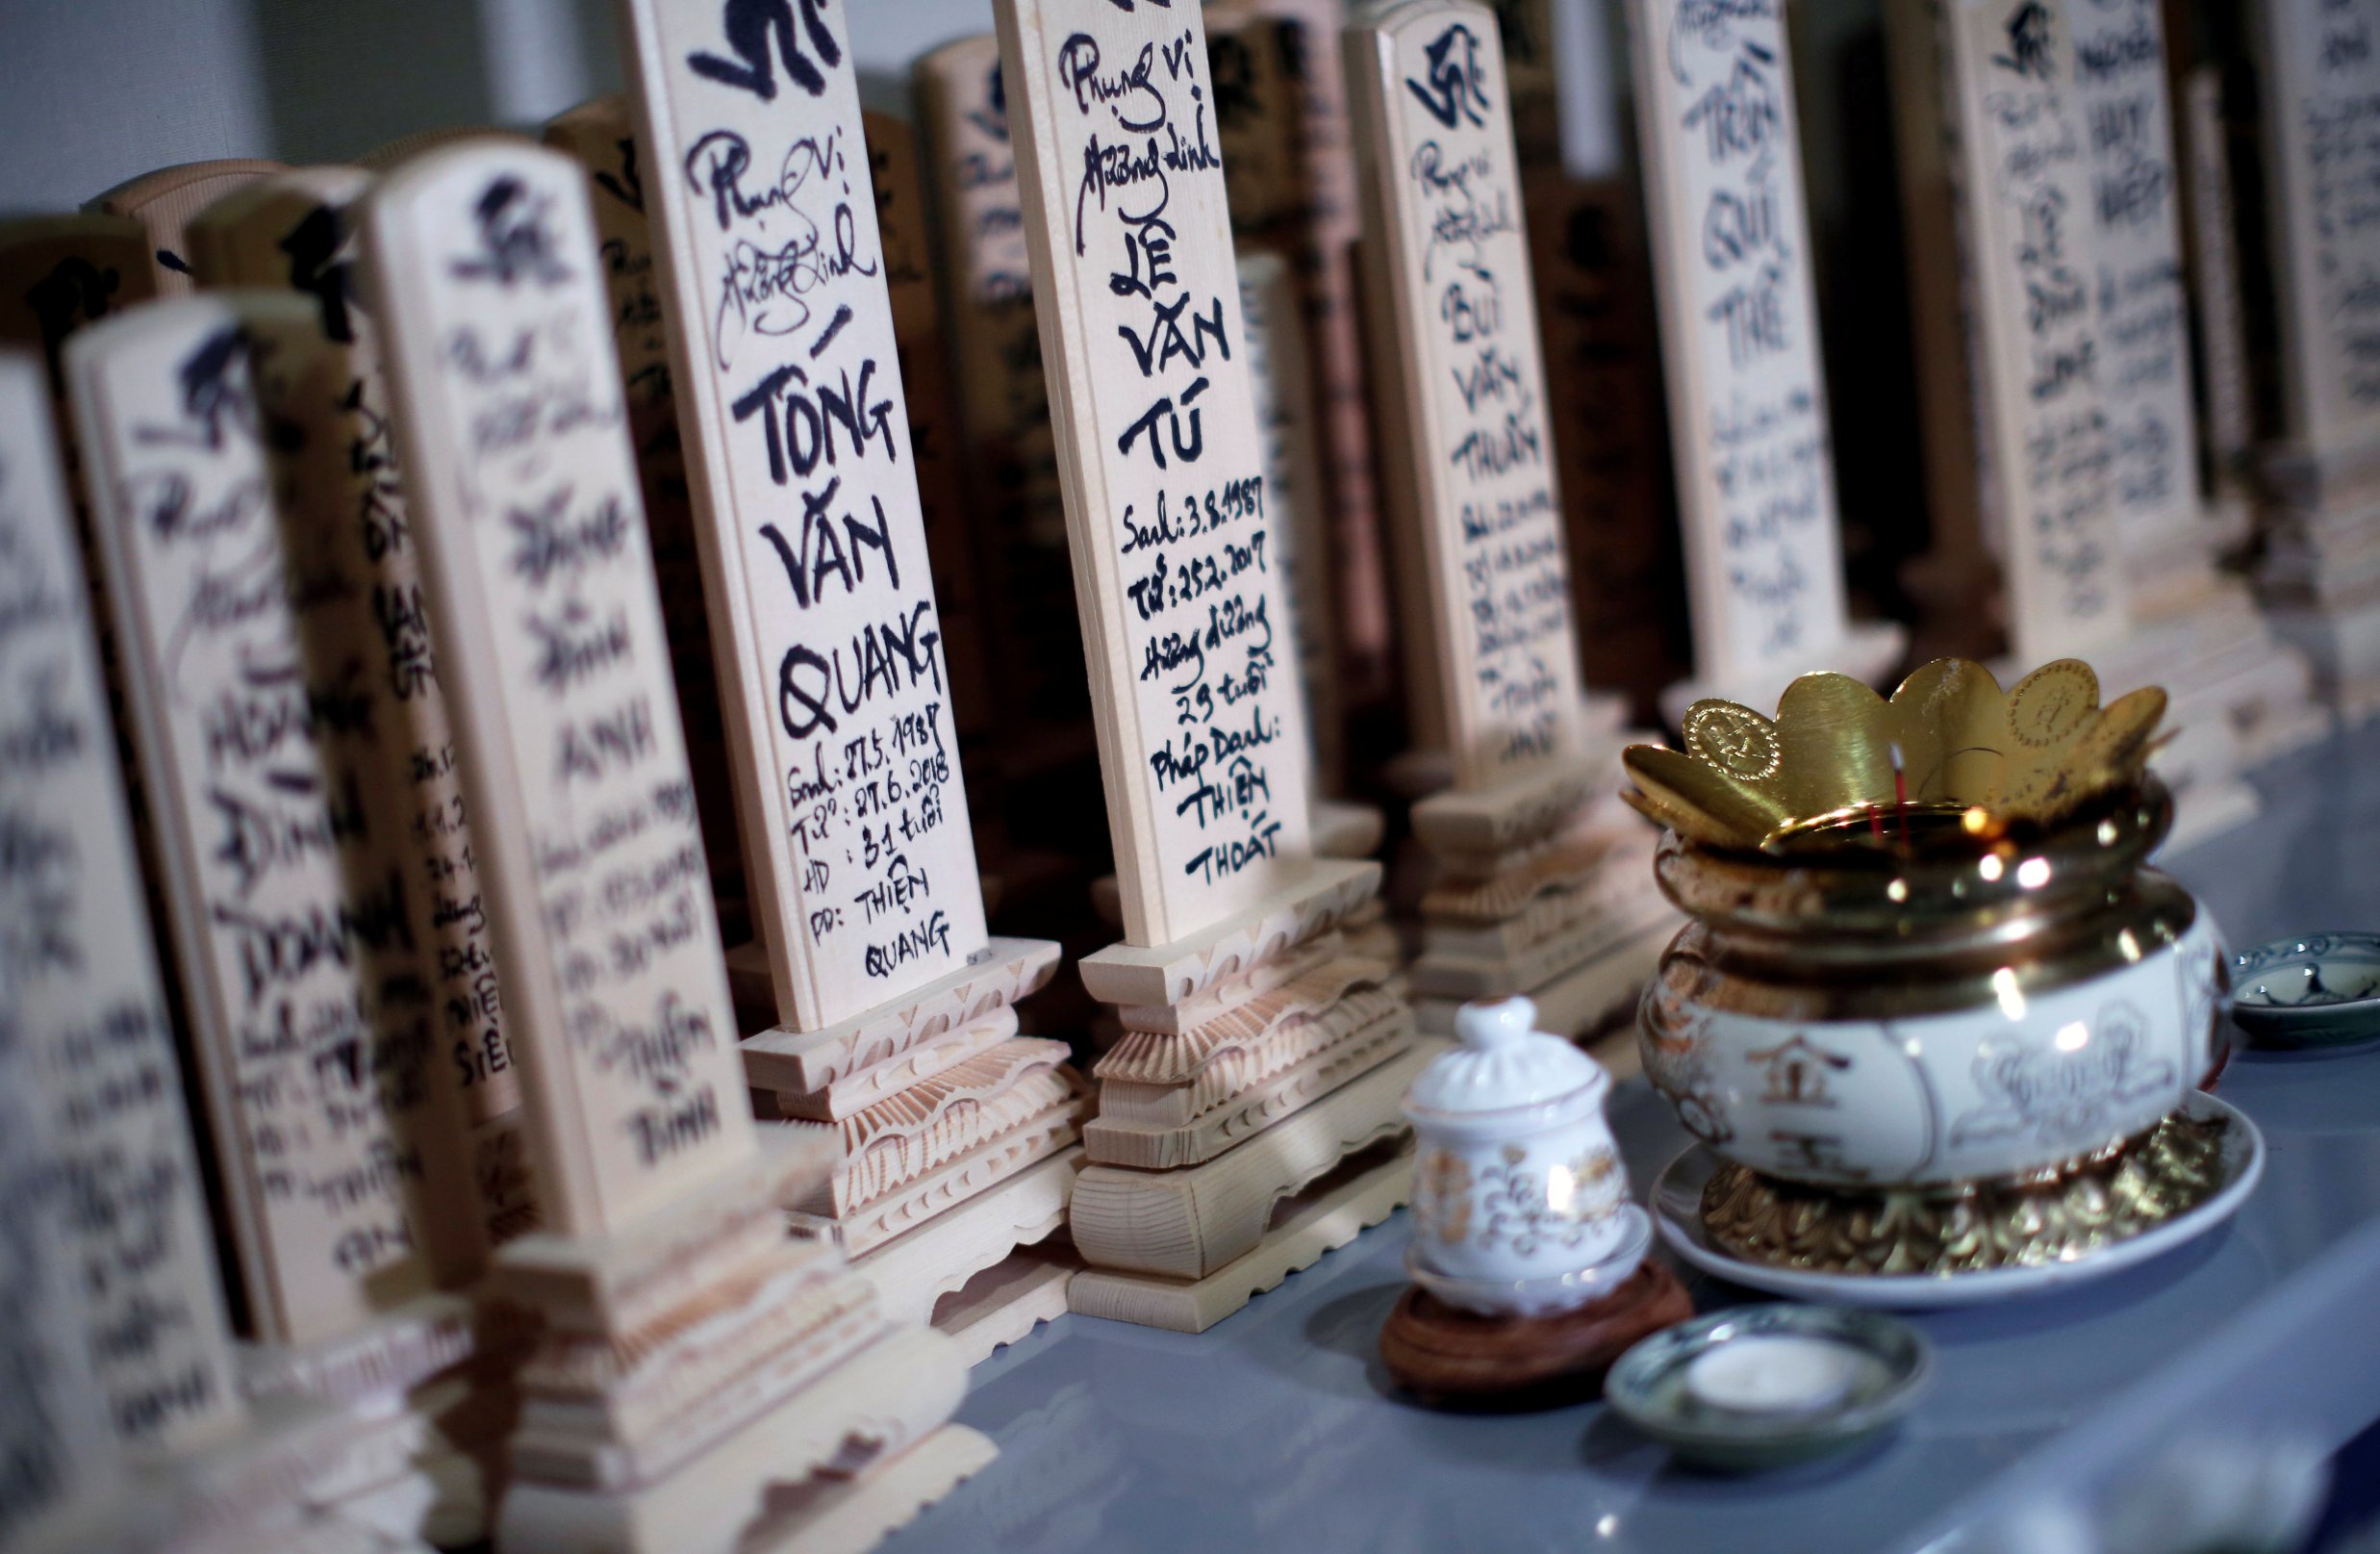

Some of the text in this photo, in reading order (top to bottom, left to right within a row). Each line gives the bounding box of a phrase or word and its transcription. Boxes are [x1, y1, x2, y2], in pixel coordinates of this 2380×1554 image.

[1109, 218, 1178, 299] LÊ
[1119, 292, 1230, 377] VĂN
[732, 304, 897, 486] TỐNG
[1118, 377, 1209, 471] TÚ
[759, 475, 899, 609] VĂN
[779, 600, 942, 740] QUANG
[1176, 683, 1214, 725] 29
[1177, 755, 1271, 829] THIỆN
[862, 822, 898, 870] 31
[1185, 810, 1281, 886] THOÁT
[854, 854, 930, 925] THIỆN
[865, 910, 950, 978] QUANG
